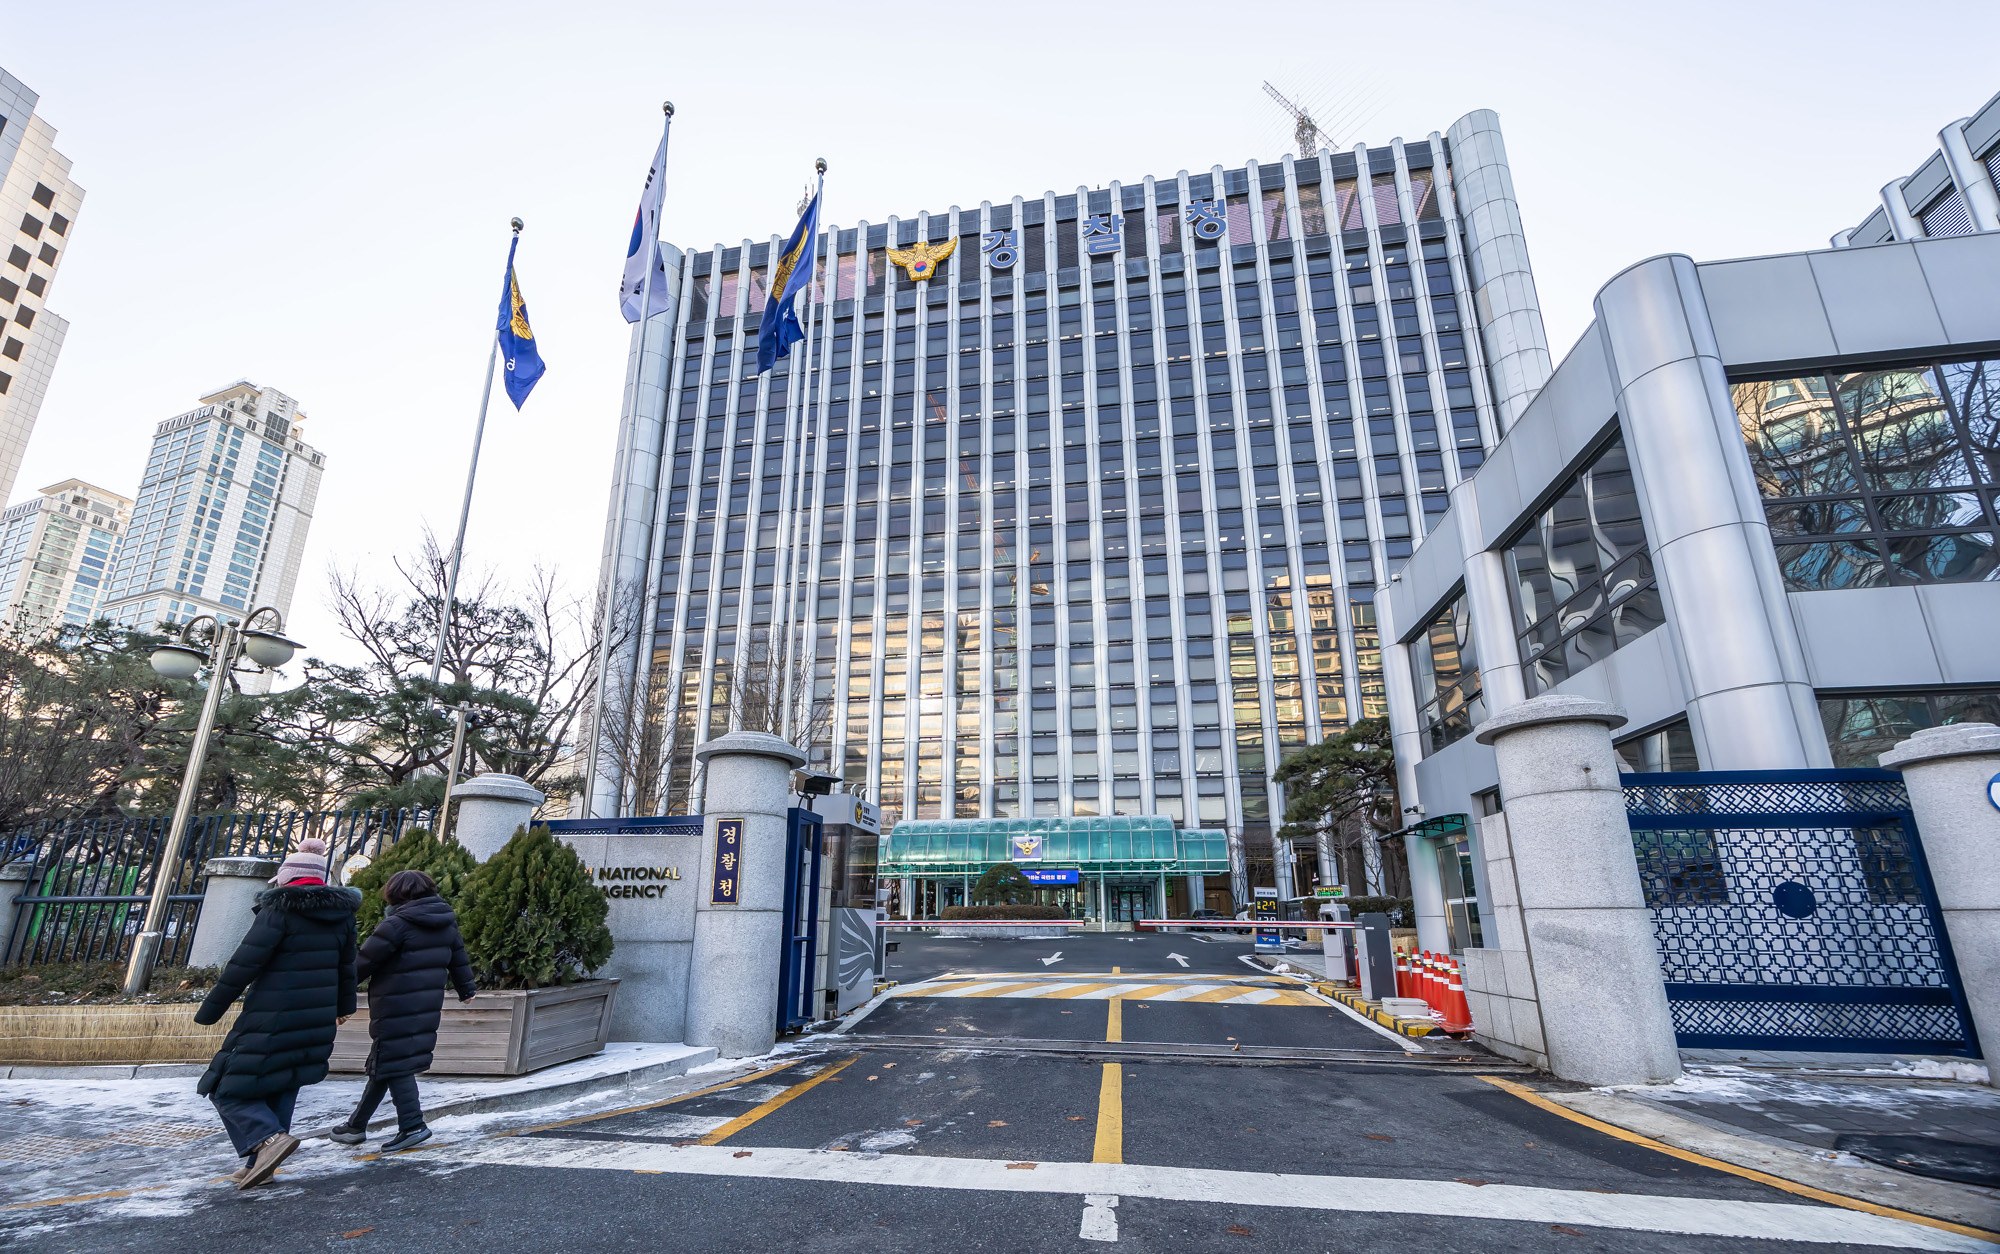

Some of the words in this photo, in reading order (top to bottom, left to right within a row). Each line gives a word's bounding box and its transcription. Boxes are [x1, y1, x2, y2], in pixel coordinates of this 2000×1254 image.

[981, 198, 1227, 269] 경찰청
[598, 866, 682, 881] NATIONAL
[719, 826, 737, 897] 경찰청
